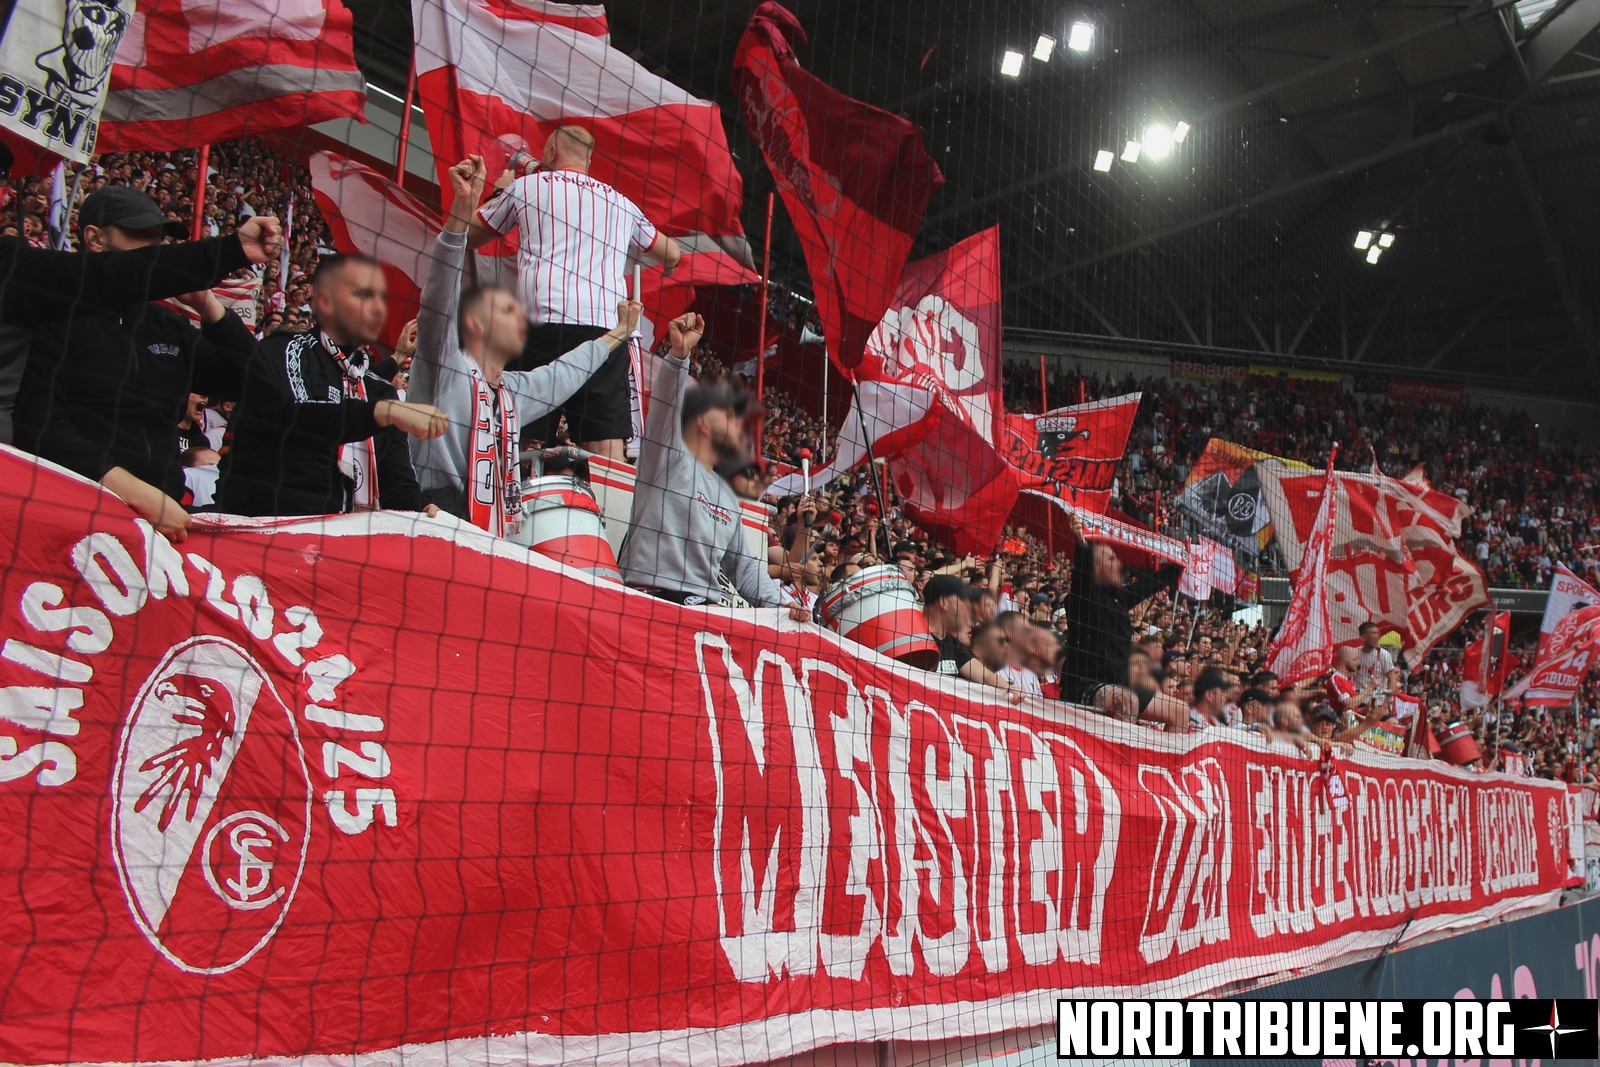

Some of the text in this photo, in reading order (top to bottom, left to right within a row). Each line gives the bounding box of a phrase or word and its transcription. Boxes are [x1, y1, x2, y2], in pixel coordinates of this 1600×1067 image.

[541, 174, 613, 194] Freiburg
[1173, 361, 1247, 380] FREIBURG
[0, 517, 190, 787] SAISON
[186, 552, 398, 835] 2024/25
[694, 631, 1121, 983] MEISTER
[1138, 757, 1232, 965] DER
